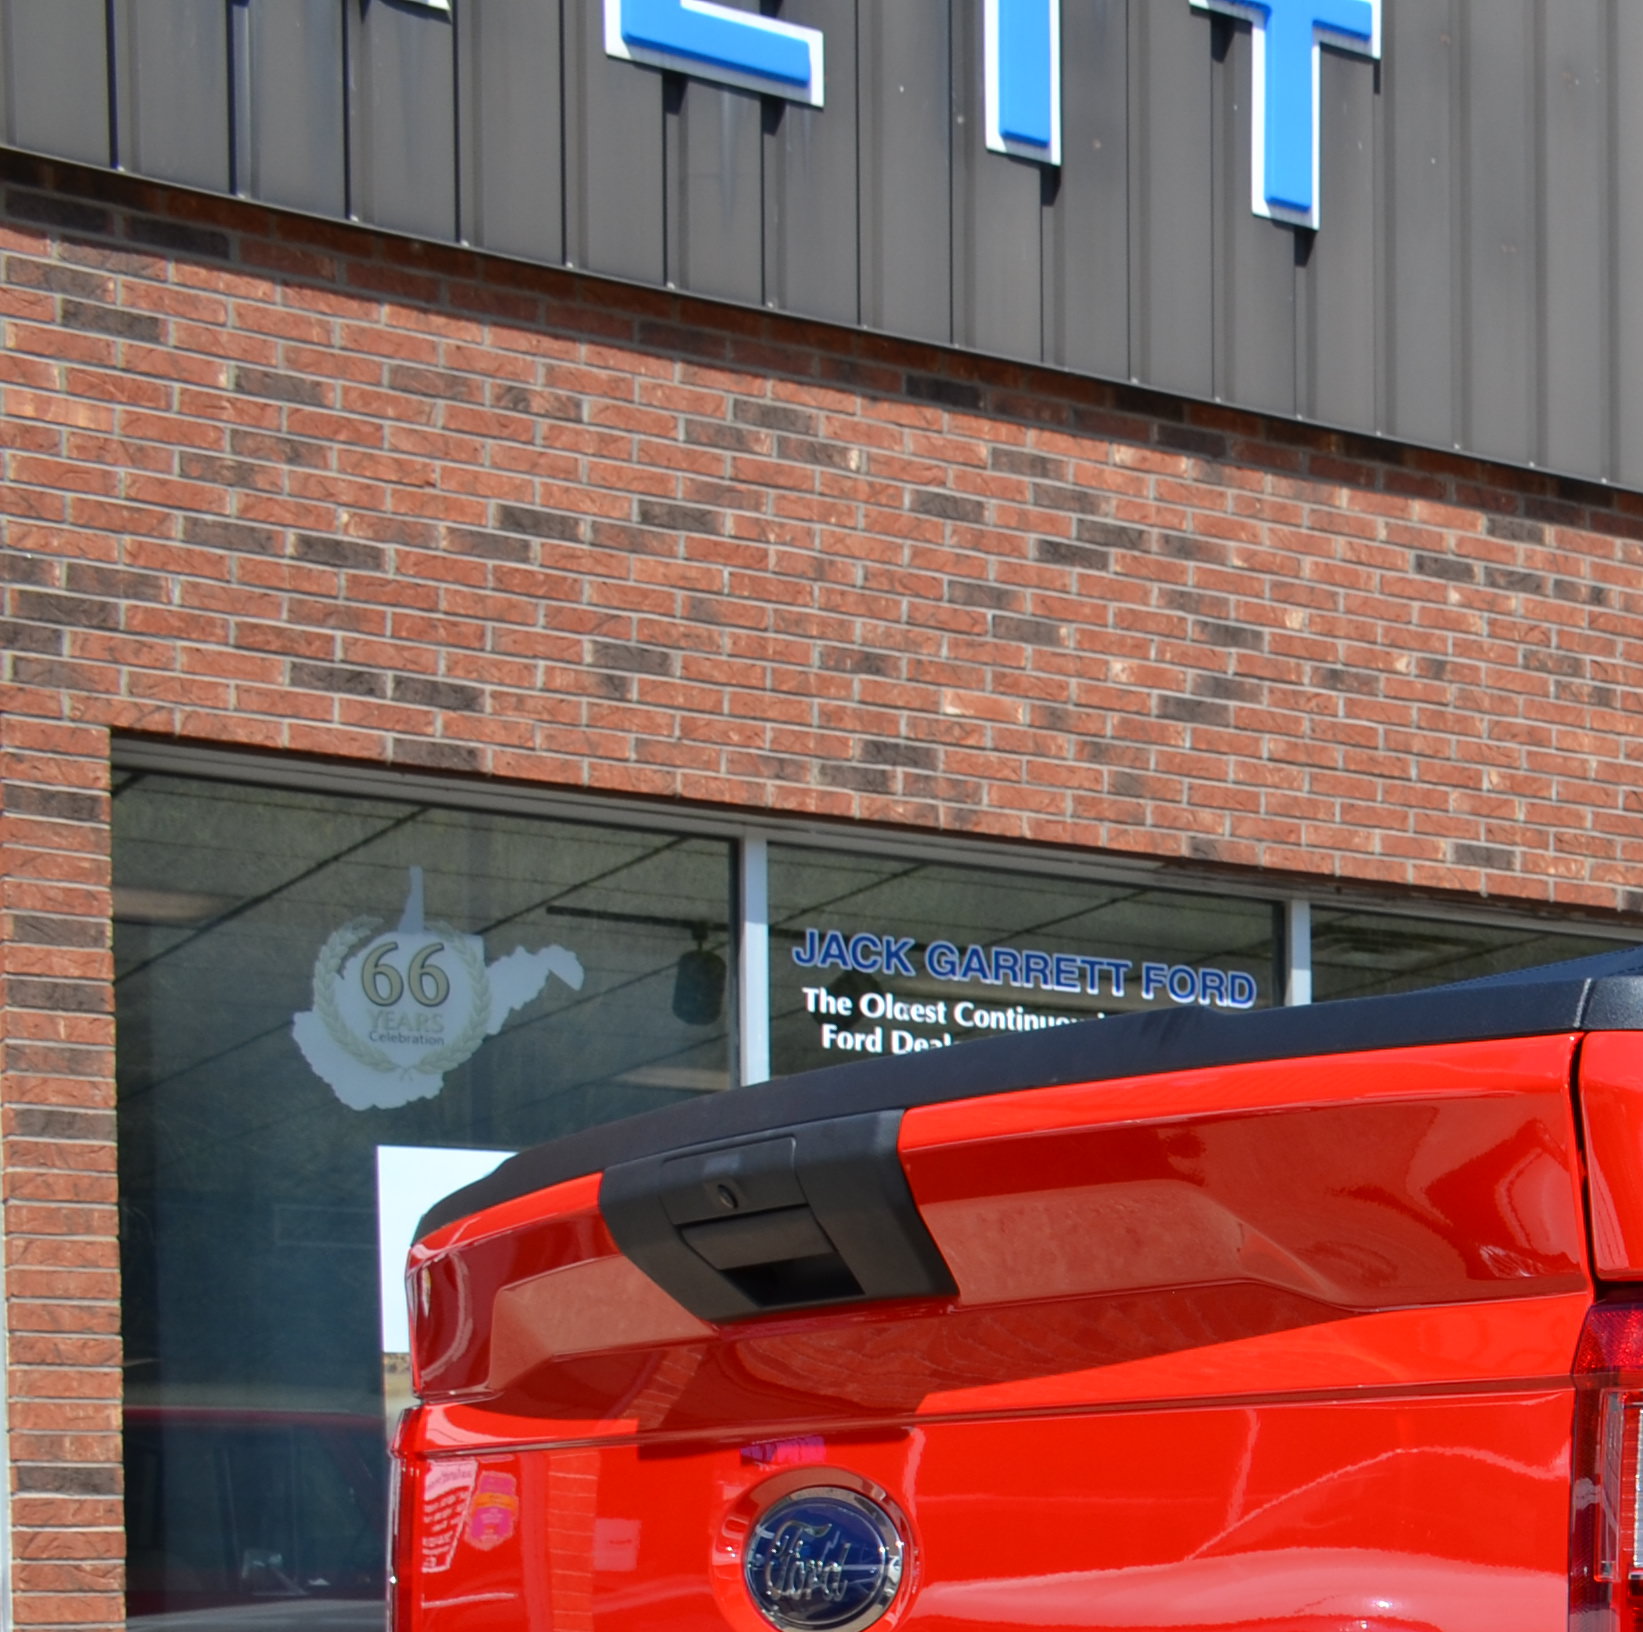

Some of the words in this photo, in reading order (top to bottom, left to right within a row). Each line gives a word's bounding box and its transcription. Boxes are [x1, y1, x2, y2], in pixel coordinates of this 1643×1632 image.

[361, 941, 450, 1008] 66
[792, 928, 917, 977] JACK
[924, 940, 1132, 997] GARRETT
[1141, 962, 1258, 1008] FORD
[367, 1009, 445, 1034] YEARS
[802, 987, 852, 1017] The
[954, 1002, 1104, 1032] Continu
[368, 1031, 445, 1046] Celebration
[821, 1024, 883, 1055] Ford
[891, 1029, 952, 1055] Deal
